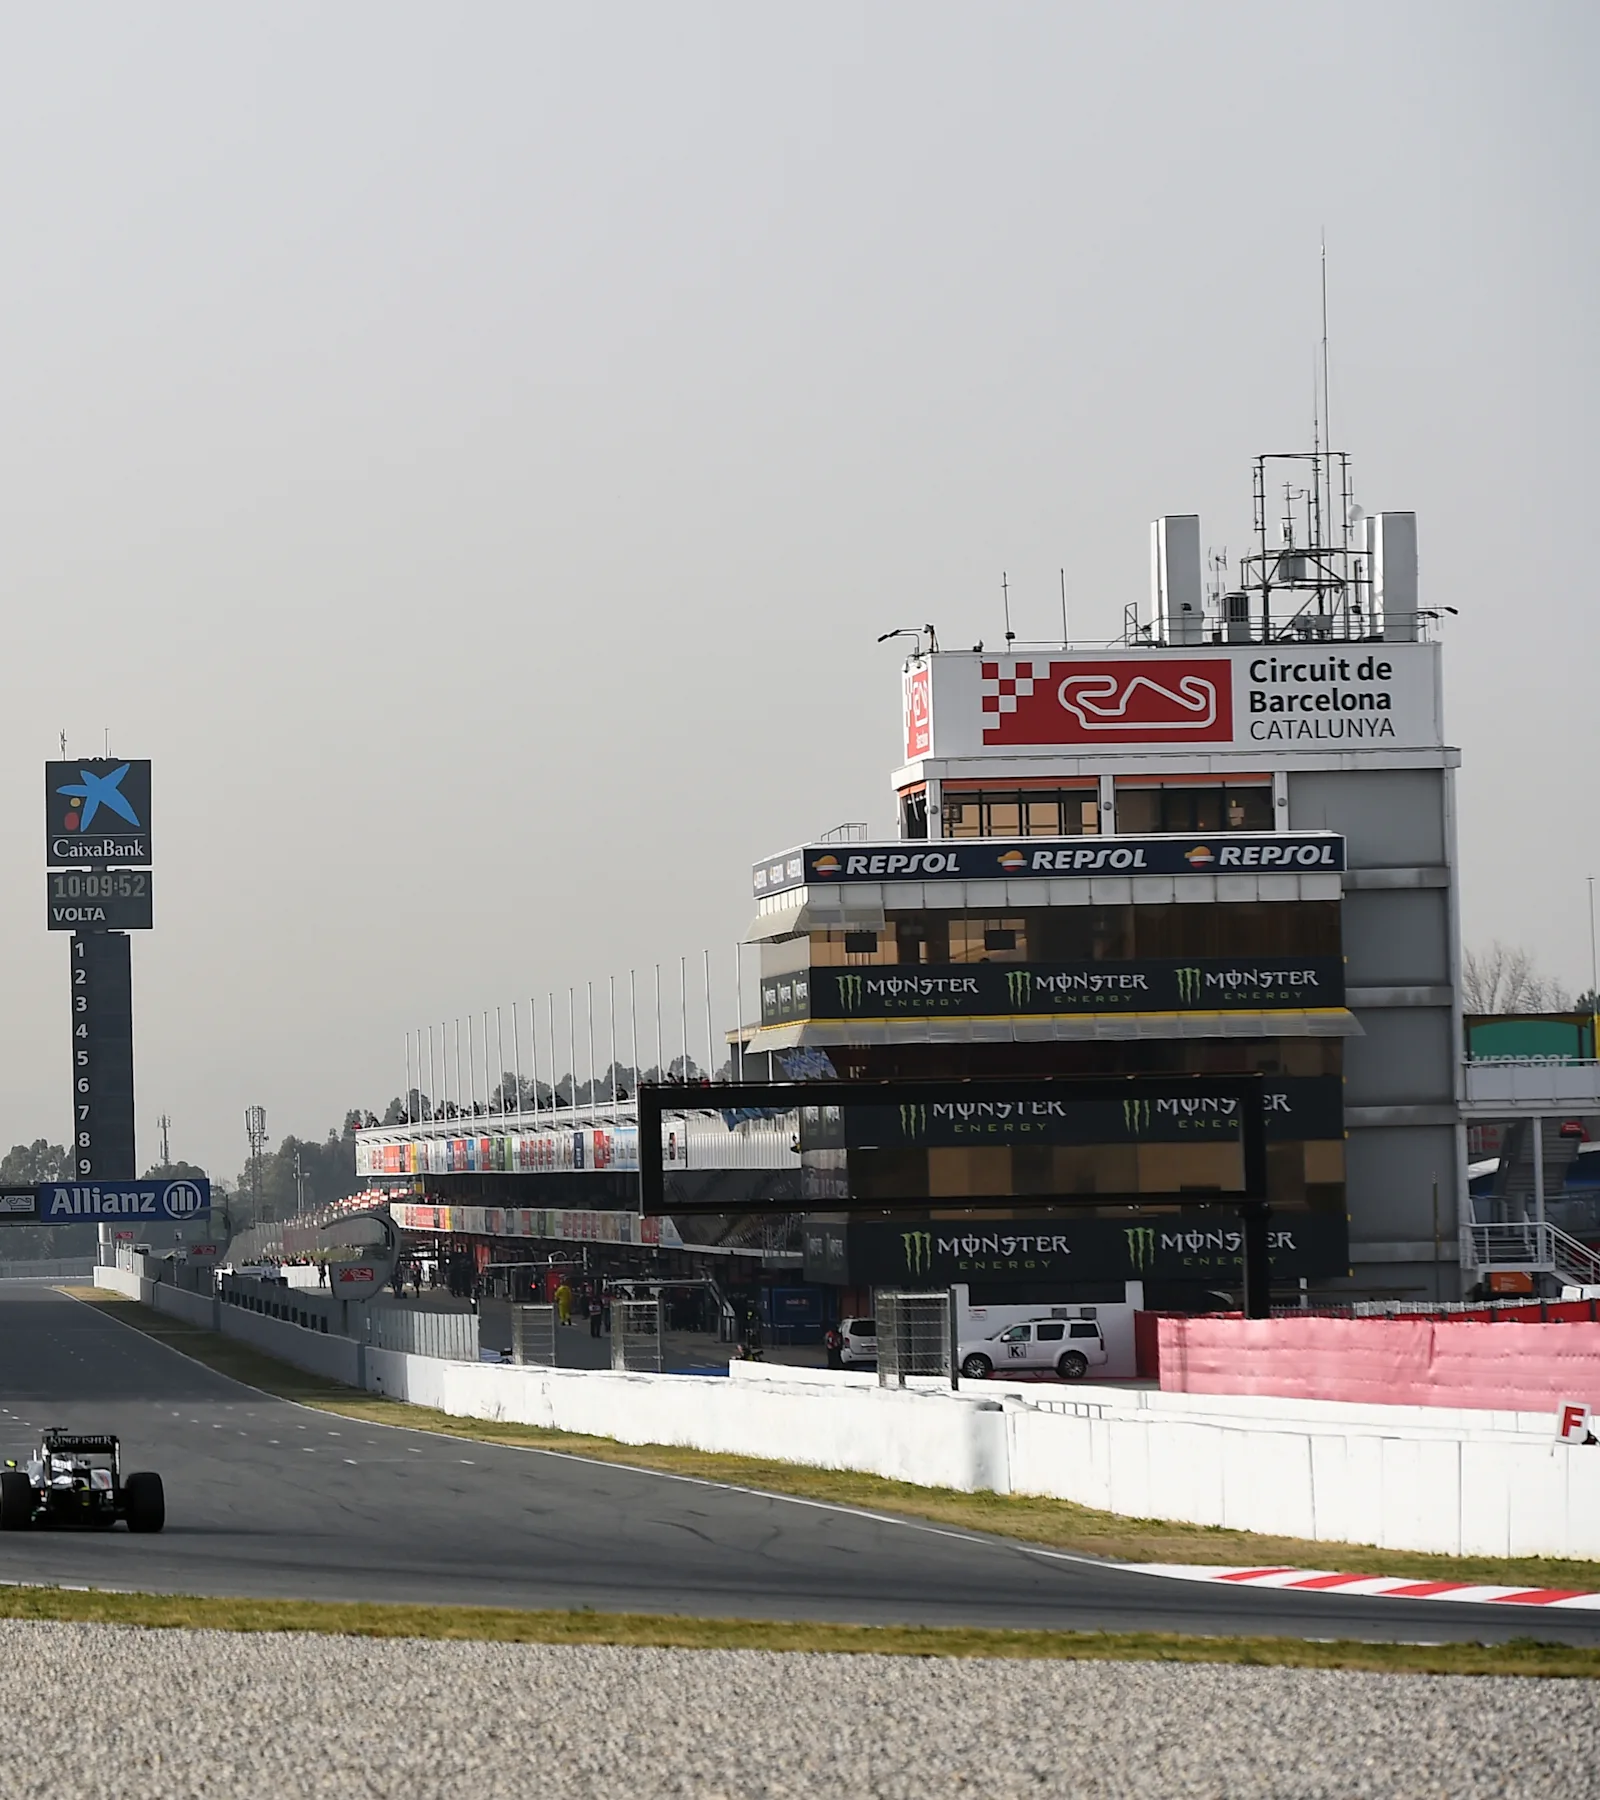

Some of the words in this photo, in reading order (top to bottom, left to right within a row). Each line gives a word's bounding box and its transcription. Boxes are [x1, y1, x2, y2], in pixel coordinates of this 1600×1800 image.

[1249, 656, 1351, 683] Circuit
[1357, 656, 1393, 681] de
[1249, 687, 1392, 713] Barcelona
[1250, 718, 1396, 741] CATALUNYA
[53, 838, 145, 858] CaixaBank
[1219, 845, 1335, 866] REPSOL
[846, 853, 961, 875] REPSOL
[1031, 848, 1148, 870] REPSOL
[53, 874, 146, 898] 10:09:52
[52, 907, 106, 921] VOLTA
[74, 942, 85, 957] 1
[74, 969, 87, 984] 2
[1036, 971, 1149, 993] MONSTER
[1205, 968, 1320, 989] MONSTER
[867, 975, 980, 997] MONSTER
[884, 998, 963, 1007] ENERGY
[1054, 994, 1132, 1003] ENERGY
[1224, 991, 1303, 1000] ENERGY
[75, 996, 88, 1012] 3
[75, 1023, 89, 1039] 4
[77, 1050, 89, 1066] 5
[77, 1077, 90, 1093] 6
[77, 1105, 90, 1120] 7
[1156, 1094, 1293, 1116] MONSER
[954, 1123, 1047, 1132] ENERGY
[1177, 1119, 1272, 1128] ENERY
[78, 1132, 91, 1147] 8
[78, 1159, 92, 1175] 9
[50, 1187, 157, 1215] Allianz
[936, 1233, 1072, 1258] MONSTER
[1160, 1229, 1297, 1253] MONSER
[959, 1260, 1052, 1270] ENERGY
[1183, 1256, 1277, 1266] ENERY
[1560, 1405, 1585, 1438] F
[50, 1435, 113, 1446] KINGFISHER
